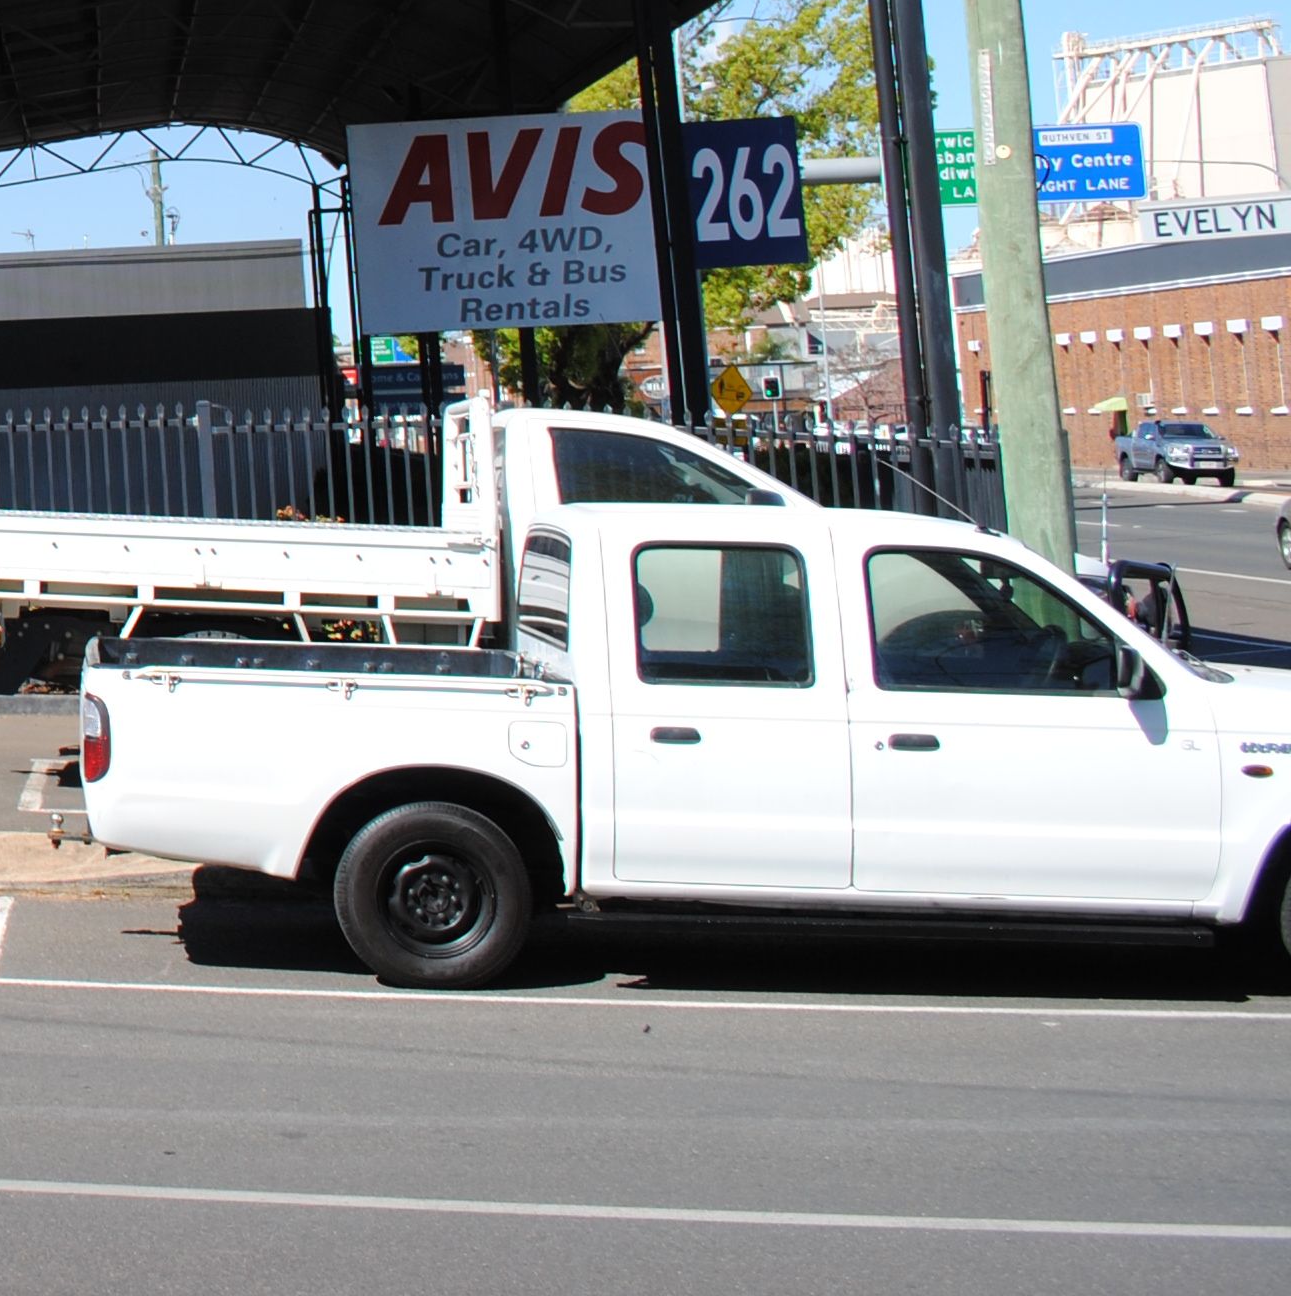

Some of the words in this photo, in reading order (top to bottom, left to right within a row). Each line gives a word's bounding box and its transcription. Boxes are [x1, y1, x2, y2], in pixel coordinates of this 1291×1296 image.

[935, 134, 973, 148] rwic
[1042, 132, 1090, 143] RUTHVEN
[1095, 131, 1108, 141] ST
[936, 150, 975, 164] sban
[1071, 153, 1134, 168] Centre
[378, 120, 647, 226] AVIS
[1085, 177, 1130, 191] LANE
[692, 143, 801, 242] 262
[1153, 204, 1277, 238] EVELYN
[436, 232, 505, 260] Car,
[518, 225, 613, 255] 4WD,
[419, 264, 518, 292] Truck
[527, 262, 549, 288] &
[562, 260, 628, 286] Bus
[460, 293, 590, 323] Rentals
